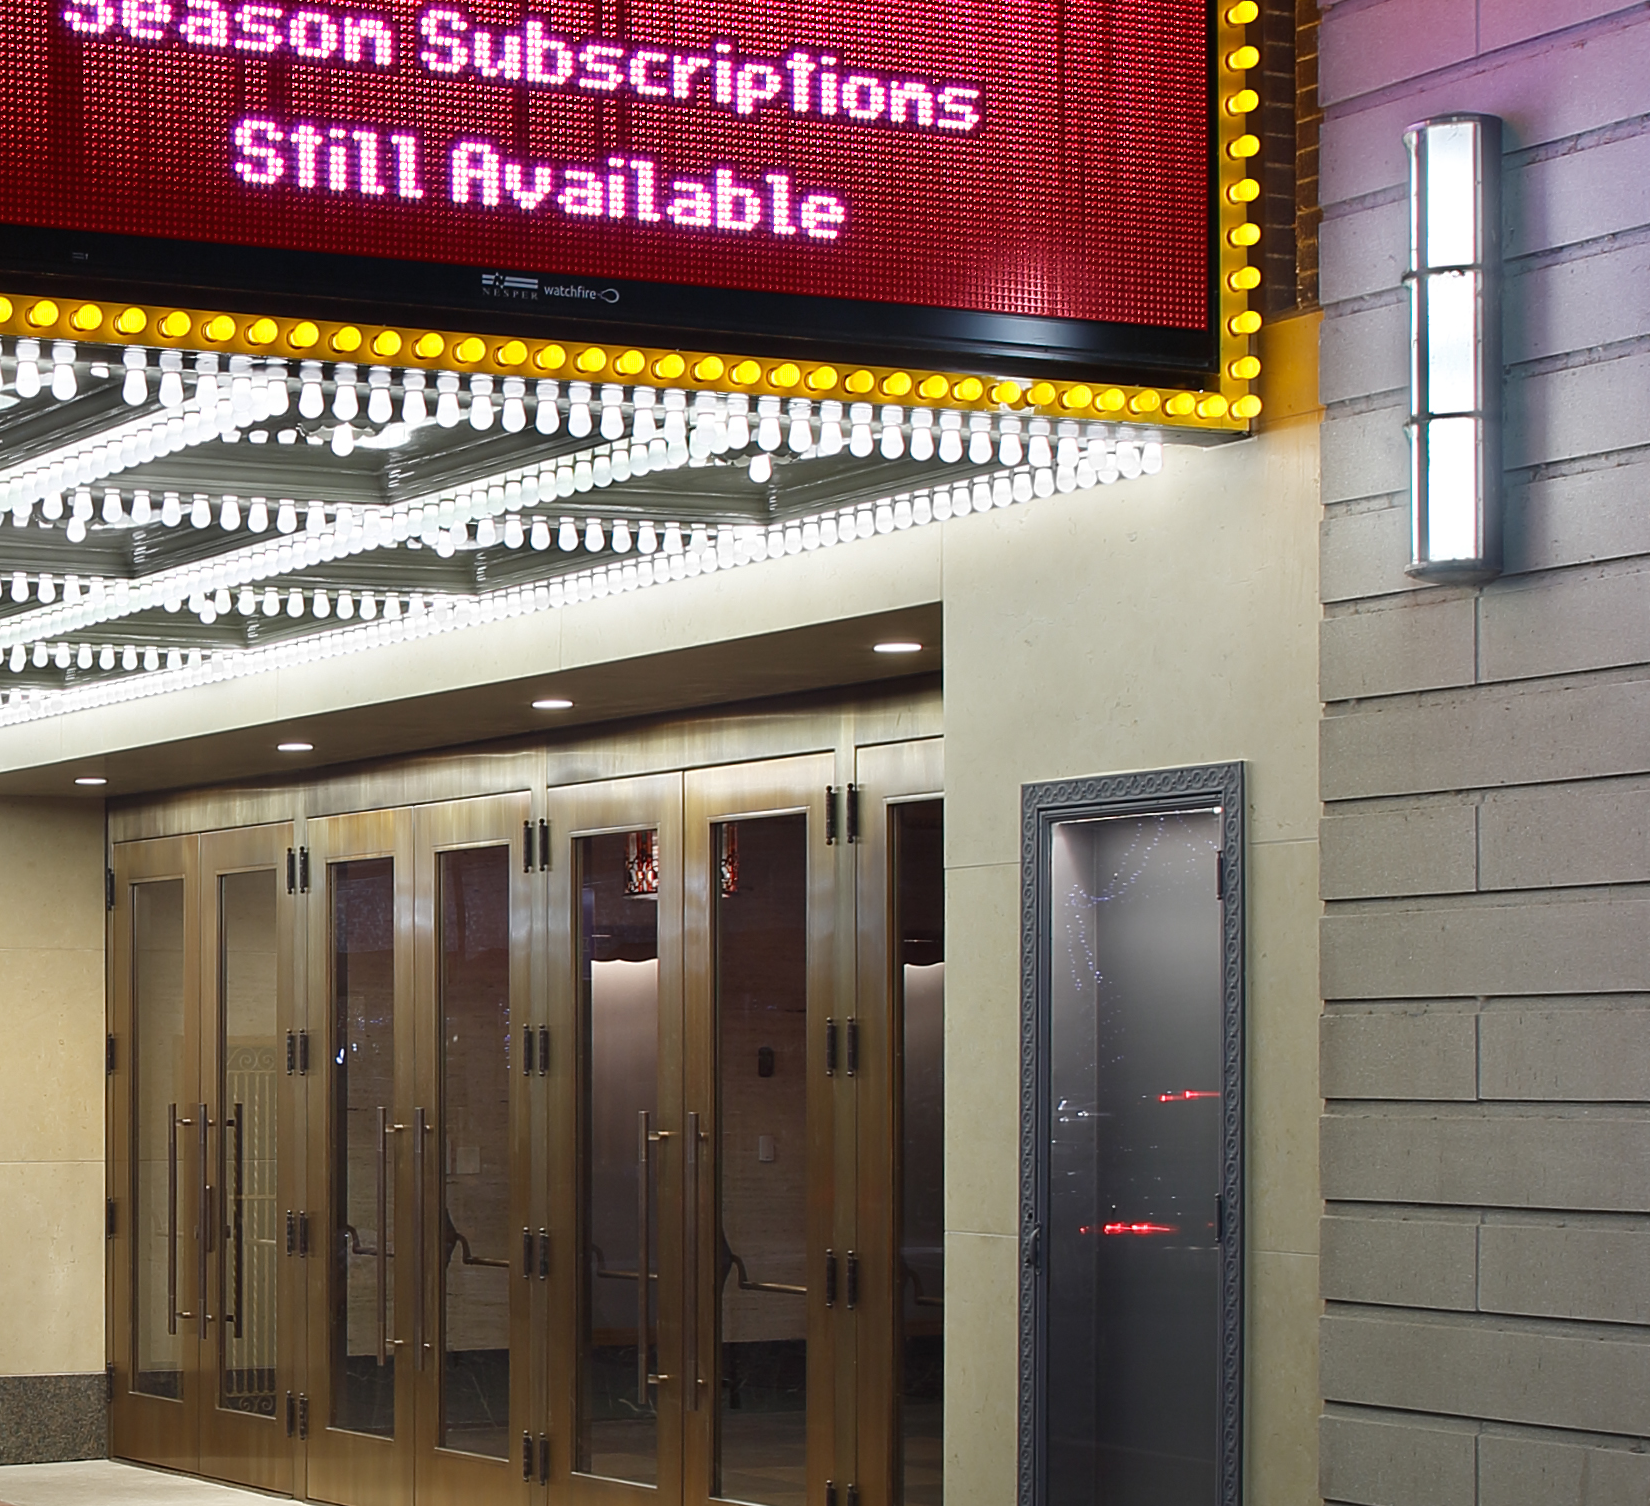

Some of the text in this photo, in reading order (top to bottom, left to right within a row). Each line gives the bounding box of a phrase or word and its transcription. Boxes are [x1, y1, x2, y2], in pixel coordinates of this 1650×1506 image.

[419, 4, 983, 135] Subscriptions
[234, 116, 848, 242] Still Available
[482, 287, 538, 300] NESPER
[544, 285, 597, 299] watchfire
